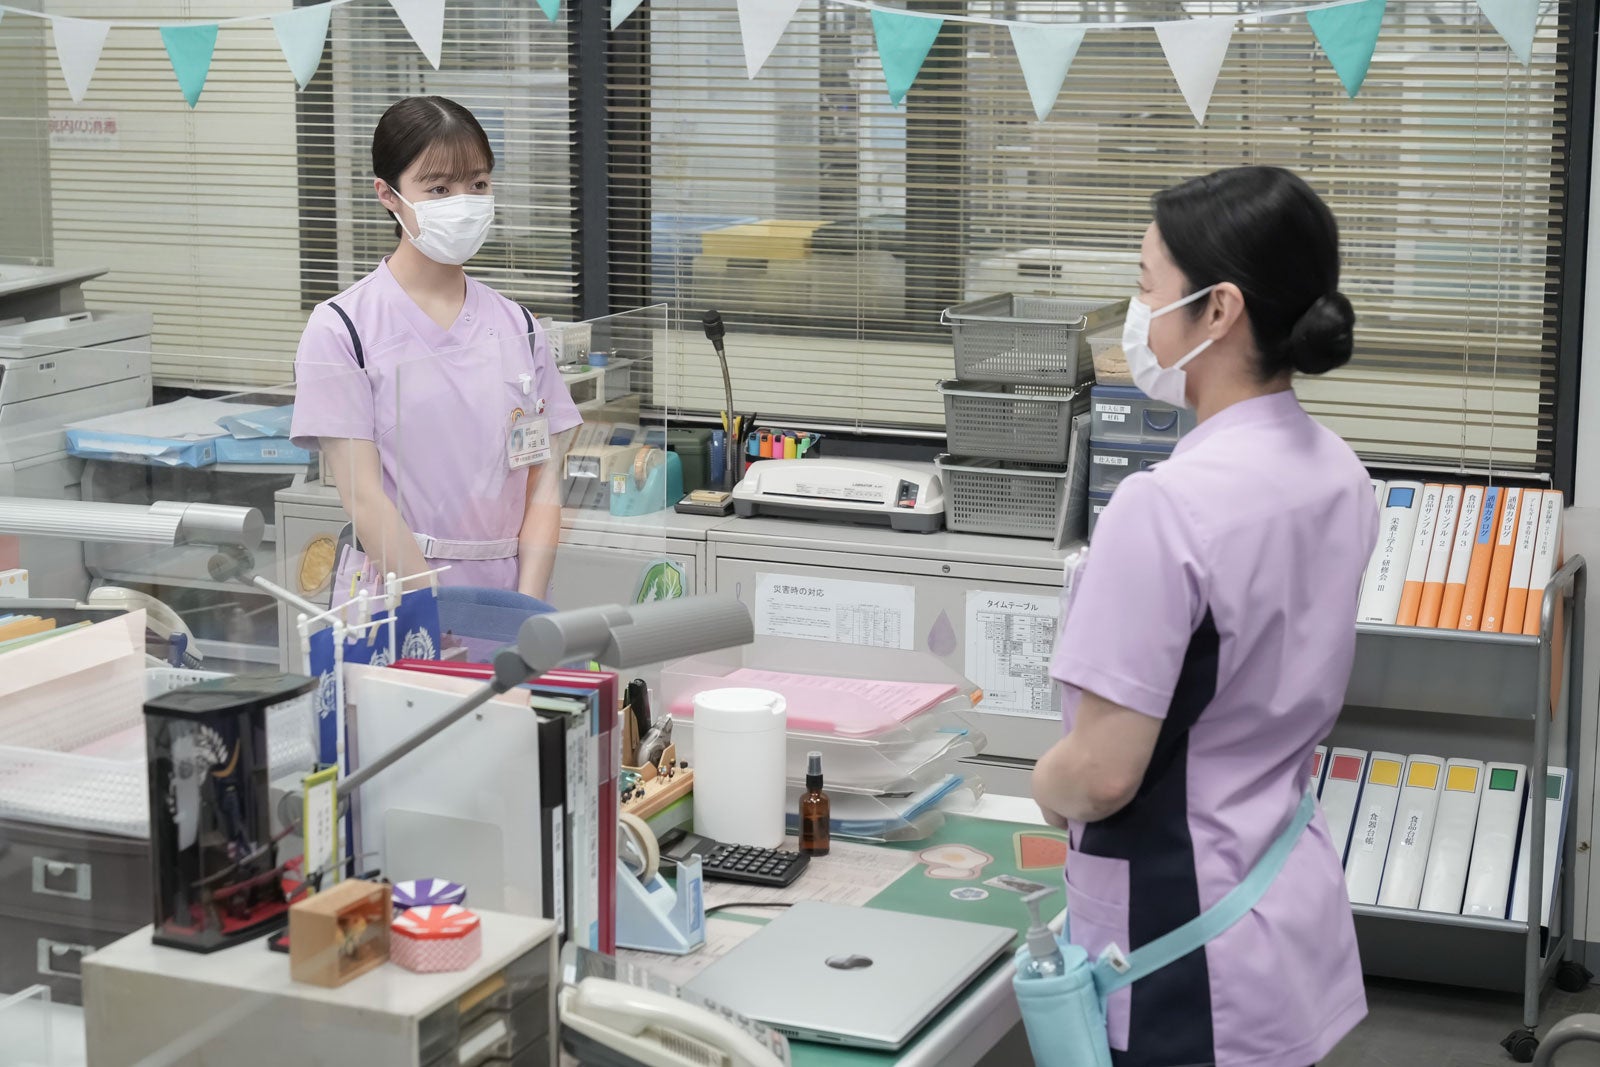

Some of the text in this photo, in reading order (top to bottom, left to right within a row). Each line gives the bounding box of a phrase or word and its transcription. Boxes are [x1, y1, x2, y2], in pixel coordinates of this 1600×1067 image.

[1421, 493, 1435, 535] 食品サンプル
[1441, 494, 1455, 536] 食品サンプル
[1462, 494, 1477, 536] 食品サンプル
[1480, 495, 1496, 537] 通販カタログ
[1502, 496, 1517, 538] 通販カタログ
[773, 584, 825, 597] 災害時の対応
[986, 600, 1039, 611] タイムテーブル
